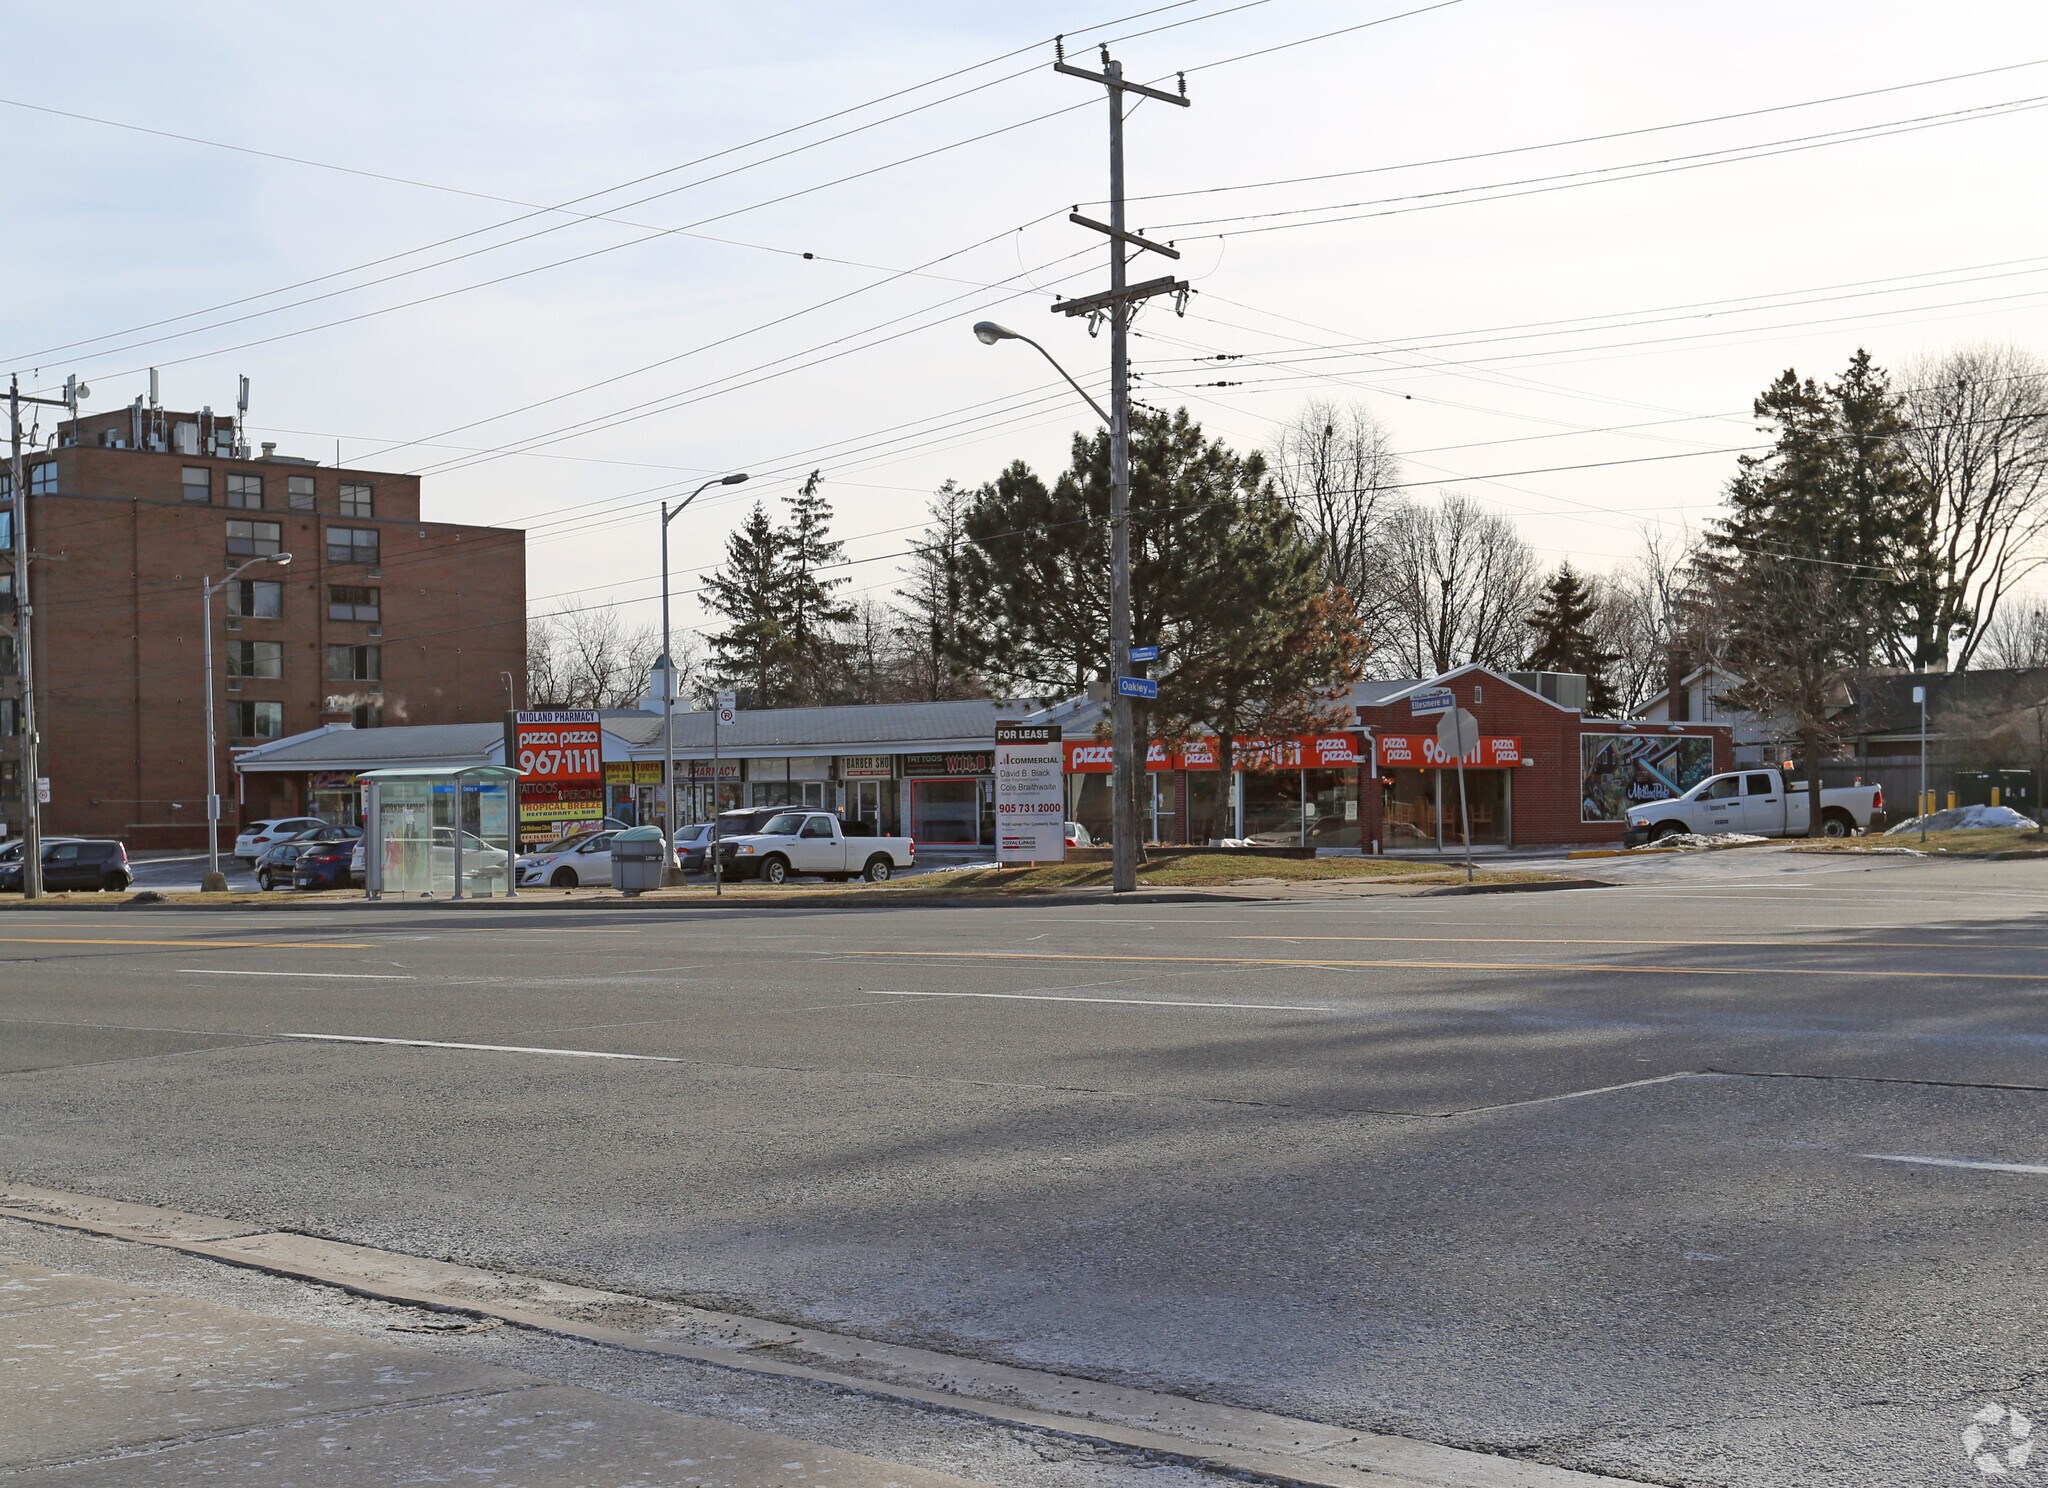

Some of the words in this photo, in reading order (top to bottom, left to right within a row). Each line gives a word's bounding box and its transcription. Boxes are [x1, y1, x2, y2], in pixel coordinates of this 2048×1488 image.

[1122, 681, 1148, 694] Oakley
[1412, 699, 1441, 709] Ellesmere
[520, 712, 552, 722] MIDLAND
[555, 711, 595, 722] PHARMACY
[519, 732, 558, 749] pizza
[560, 731, 598, 748] pizza
[998, 730, 1016, 740] FOR
[1019, 730, 1049, 739] LEASE
[1316, 738, 1346, 753] pizza
[1383, 738, 1407, 752] pizza
[1492, 740, 1514, 752] pizza
[846, 757, 872, 769] BARBER
[876, 756, 889, 768] SHO
[907, 754, 942, 764] TATTOOS
[1184, 752, 1213, 766] pizza
[1322, 750, 1353, 764] pizza
[1387, 750, 1412, 764] pizza
[1496, 751, 1518, 764] pizza
[606, 763, 630, 772] POOJA
[636, 762, 660, 772] TORES
[1000, 770, 1020, 778] David
[1032, 769, 1050, 777] Black
[520, 783, 558, 794] TATTOOS
[564, 788, 602, 800] PIERCING
[521, 803, 566, 812] TROPICAL
[568, 801, 602, 810] BREEZE
[1000, 804, 1016, 812] 905
[1018, 804, 1034, 812] 731
[1038, 803, 1060, 812] 2000
